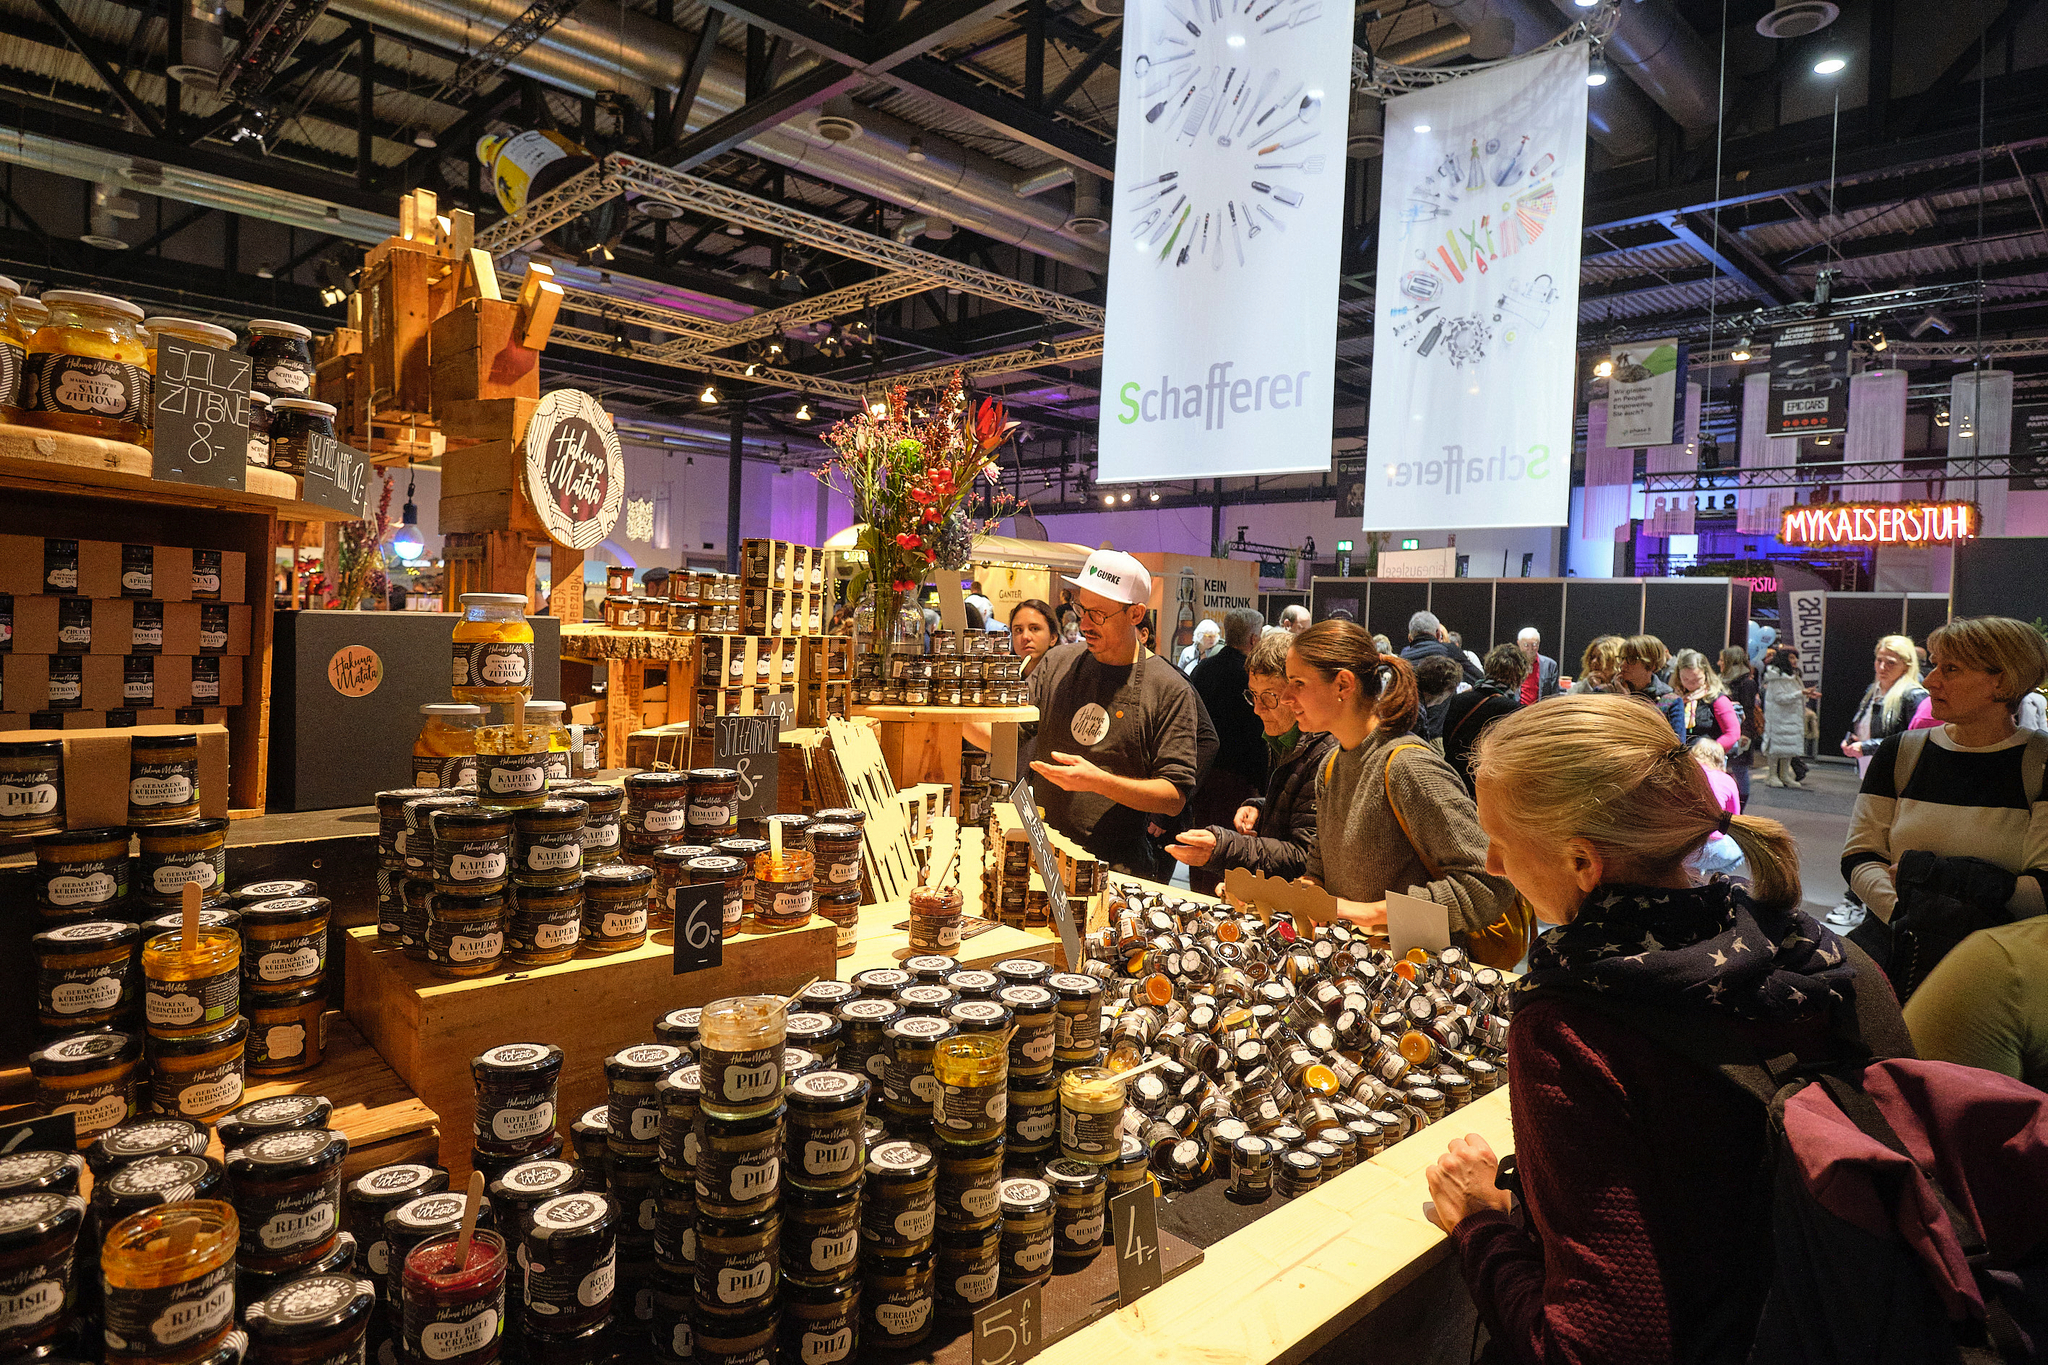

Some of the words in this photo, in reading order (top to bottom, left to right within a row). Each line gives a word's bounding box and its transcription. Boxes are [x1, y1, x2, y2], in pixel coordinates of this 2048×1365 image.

[79, 384, 108, 396] SALZ
[1118, 362, 1311, 430] Schafferer
[66, 392, 120, 408] ZITRONE
[1613, 402, 1653, 410] Empowering
[1787, 402, 1804, 412] EPIC
[1805, 400, 1825, 411] CARS
[555, 425, 605, 476] Hakuna
[550, 454, 602, 504] Matata
[1096, 569, 1121, 586] GURKE
[1204, 579, 1227, 593] KEIN
[1204, 595, 1251, 609] UMTRUNK
[332, 651, 374, 678] Hakuna
[498, 663, 517, 671] SALZ
[337, 664, 378, 692] Matata
[489, 670, 522, 679] ZITRONE
[1079, 707, 1105, 724] Hakuna
[1074, 720, 1102, 737] Matata
[498, 774, 538, 785] KAPERN
[6, 791, 49, 806] PILZ
[650, 814, 682, 824] TOMATEN
[692, 810, 724, 818] TOMATEN
[584, 830, 615, 841] KAPERN
[537, 850, 575, 861] KAPERN
[460, 859, 500, 870] KAPERN
[780, 896, 810, 906] TOMATEN
[612, 916, 644, 928] KAPERN
[545, 926, 578, 939] KAPERN
[460, 940, 499, 952] KAPERN
[464, 948, 494, 957] TAPENADE
[735, 1069, 772, 1090] PILZ
[504, 1116, 527, 1124] ROTE
[529, 1109, 548, 1121] BETE
[513, 1119, 540, 1130] CREME
[814, 1146, 850, 1164] PILZ
[742, 1165, 776, 1189] PILZ
[276, 1209, 326, 1234] RELISH
[822, 1236, 853, 1260] PILZ
[590, 1273, 608, 1289] ROTE
[730, 1270, 766, 1293] PILZ
[172, 1291, 226, 1326] RELISH
[883, 1304, 928, 1320] BERGLINSEN
[894, 1313, 919, 1326] PASTE
[434, 1330, 460, 1340] ROTE
[465, 1320, 488, 1336] BETE
[445, 1332, 479, 1347] CREME
[812, 1334, 848, 1357] PILZ
